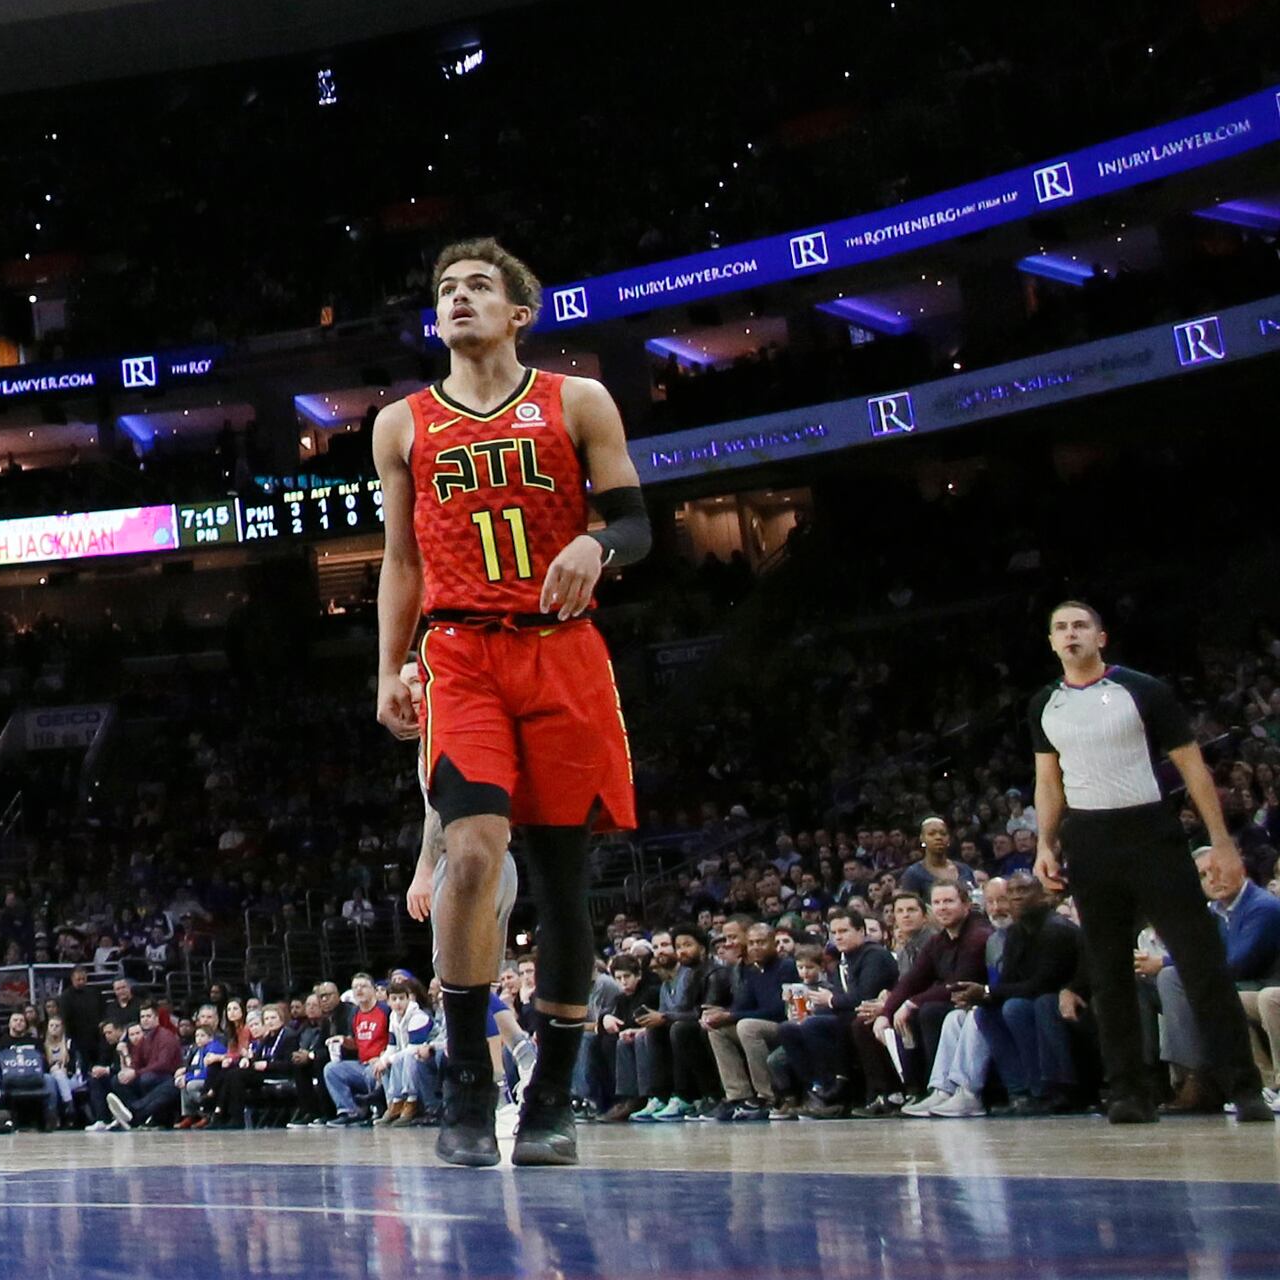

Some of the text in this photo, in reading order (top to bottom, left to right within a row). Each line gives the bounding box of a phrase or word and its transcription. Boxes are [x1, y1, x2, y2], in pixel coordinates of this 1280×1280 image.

[863, 207, 956, 246] ROTHENBERG
[431, 436, 556, 504] ATL
[180, 506, 230, 529] 7:15
[245, 504, 275, 523] PHI
[290, 501, 301, 517] 3
[318, 497, 328, 513] 1
[344, 494, 357, 510] 0
[195, 527, 220, 543] PM
[245, 521, 279, 540] ATL
[291, 518, 303, 534] 2
[319, 514, 330, 530] 1
[346, 510, 358, 527] 0
[15, 527, 117, 558] JACKMAN
[471, 505, 534, 583] 11
